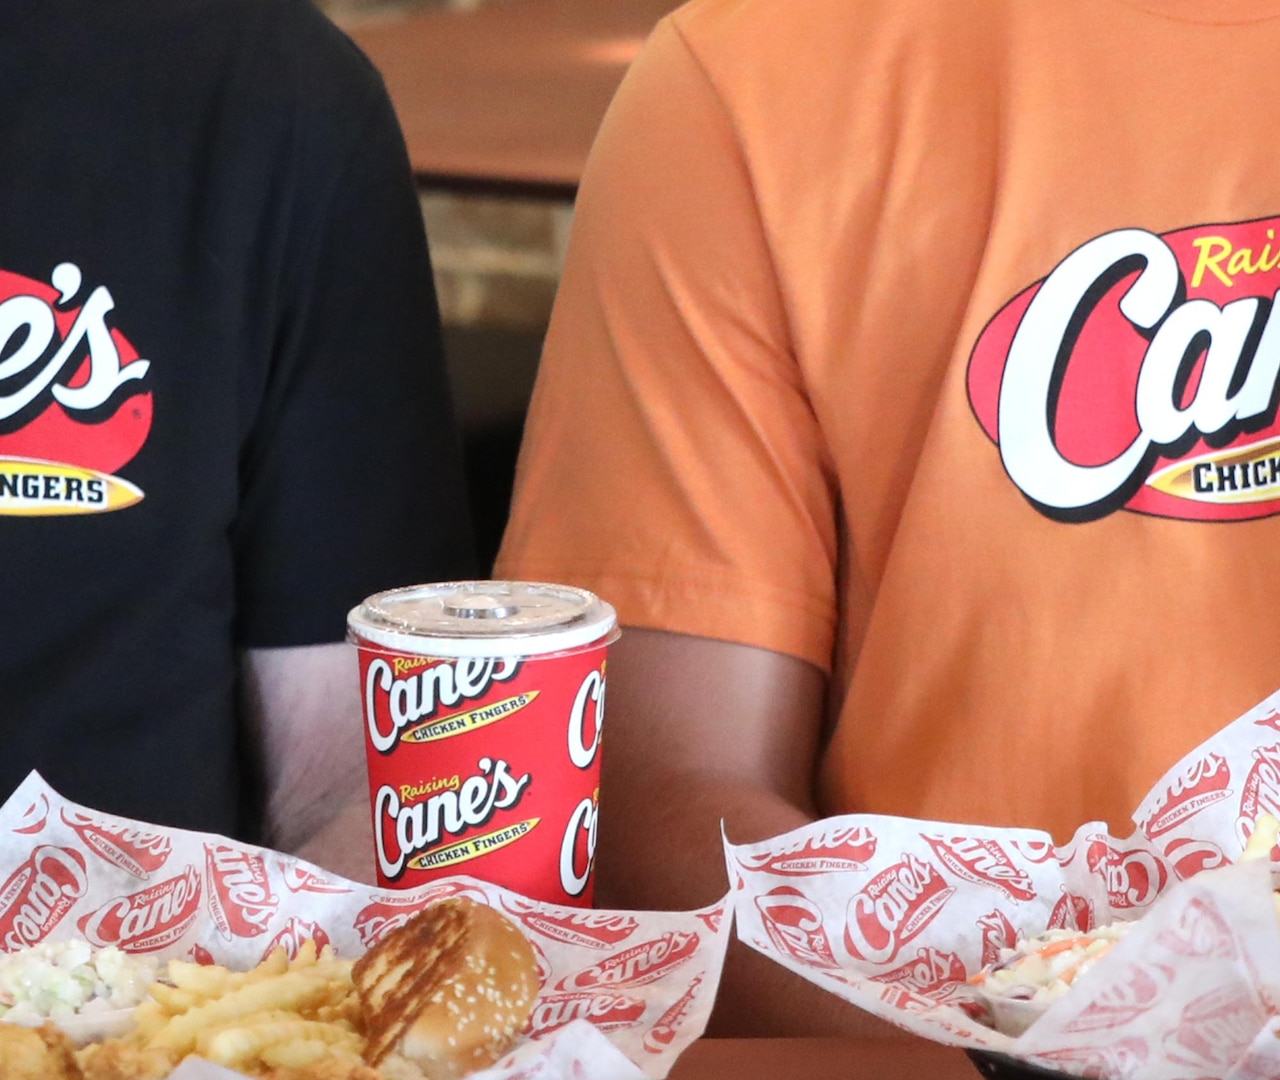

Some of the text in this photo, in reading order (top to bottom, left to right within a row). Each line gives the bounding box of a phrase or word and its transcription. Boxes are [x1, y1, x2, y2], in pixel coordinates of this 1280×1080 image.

[412, 695, 527, 741] CHICKEN FINGERS
[400, 775, 460, 802] Raising
[375, 758, 529, 878] Cane's
[1156, 790, 1226, 829] CHICKEN FINGERS
[88, 832, 118, 858] CHICKEN
[420, 822, 528, 868] CHICKEN FINGERS
[780, 860, 858, 869] CHICKEN FINGERS
[942, 852, 975, 880] CHICKEN
[4, 873, 29, 903] CHICKEN
[133, 881, 175, 908] Raising
[85, 864, 200, 949] Cane's
[846, 852, 931, 965] Cane's
[905, 905, 932, 934] CHICKEN
[133, 934, 171, 949] CHICKEN
[533, 919, 607, 949] CHICKEN FINGERS
[563, 931, 697, 990] Cane's
[604, 944, 651, 970] Raising
